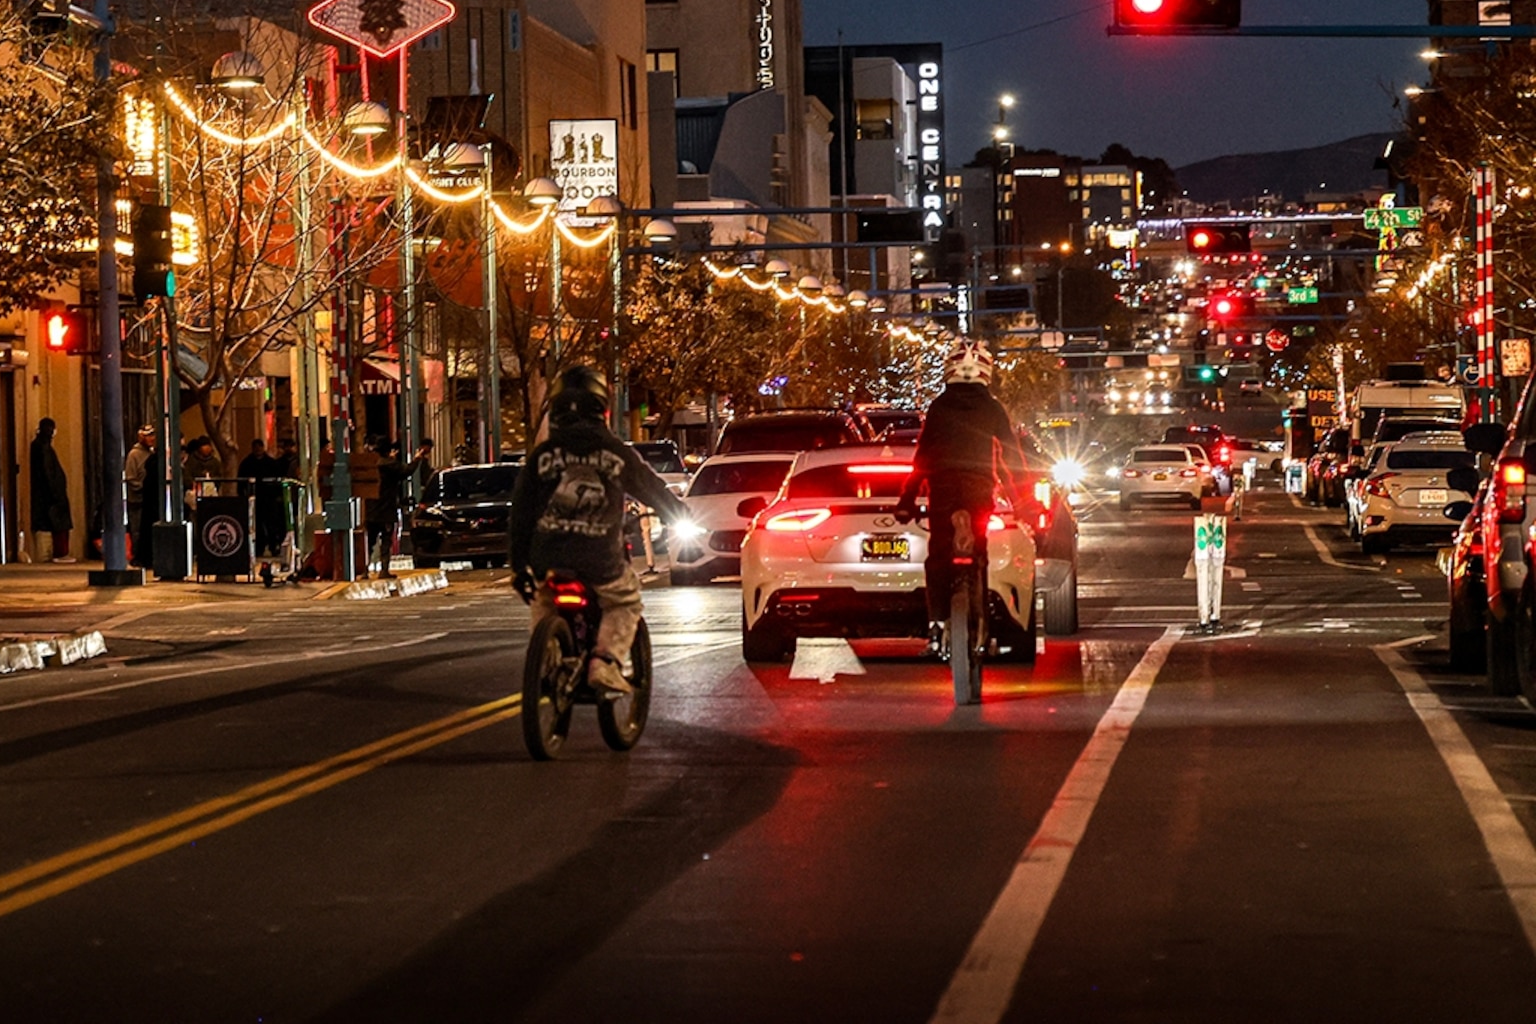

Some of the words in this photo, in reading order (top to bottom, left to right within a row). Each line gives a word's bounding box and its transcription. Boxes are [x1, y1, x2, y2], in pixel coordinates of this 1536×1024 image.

[919, 62, 939, 112] ONE
[561, 184, 616, 200] OOTS
[921, 128, 944, 242] CENTRAL
[1367, 210, 1401, 227] 4th
[1407, 209, 1421, 222] St
[1289, 289, 1307, 304] 3rd
[1308, 389, 1336, 402] USE
